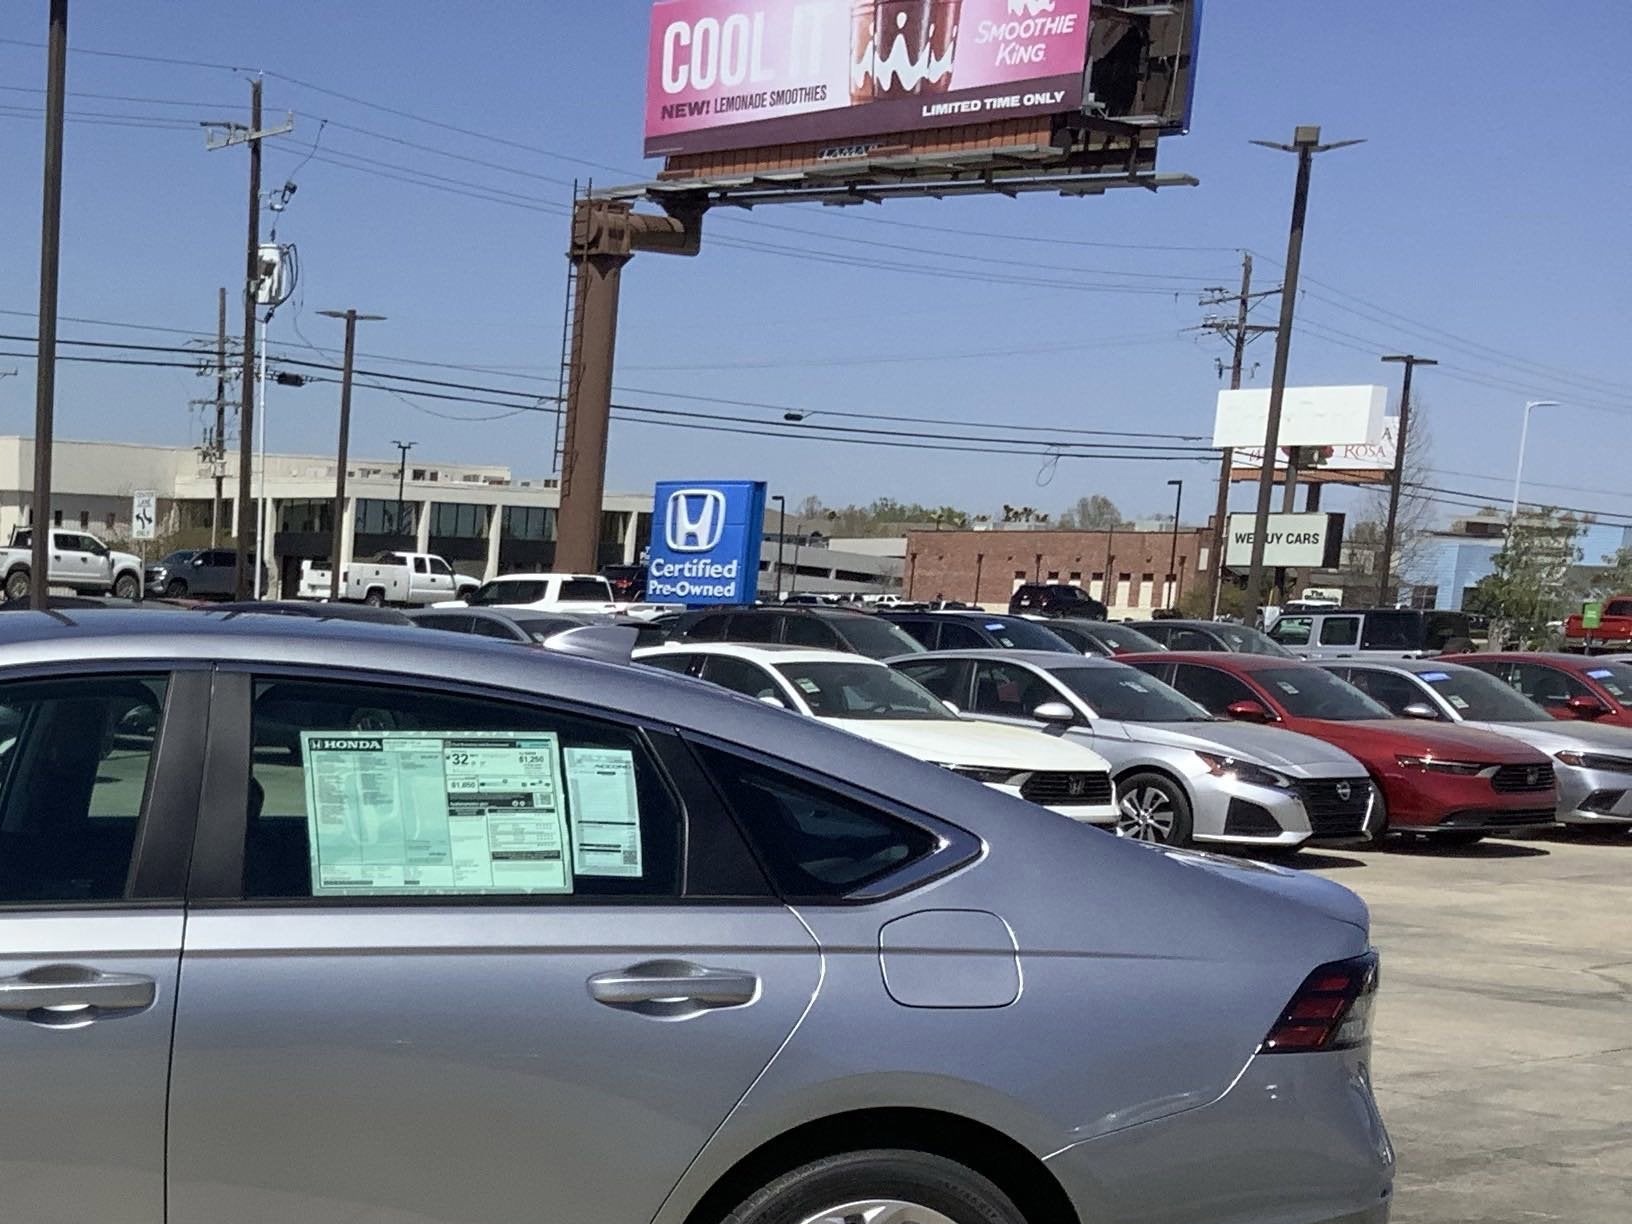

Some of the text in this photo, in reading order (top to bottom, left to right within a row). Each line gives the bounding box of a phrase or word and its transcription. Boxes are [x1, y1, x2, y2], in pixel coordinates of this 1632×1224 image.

[975, 13, 1077, 44] SMOOTHIE
[661, 12, 775, 94] COOL
[661, 84, 827, 120] NEW! LEMONADE SMOOTHIES
[922, 91, 1065, 117] LIMITED TIME ONLY
[1344, 445, 1386, 459] ROSA
[1235, 533, 1255, 544] WE
[1286, 533, 1320, 545] CARS
[650, 558, 738, 578] Certified
[648, 580, 736, 597] Pre-Owned
[324, 740, 382, 749] HONDA
[452, 753, 469, 765] 32
